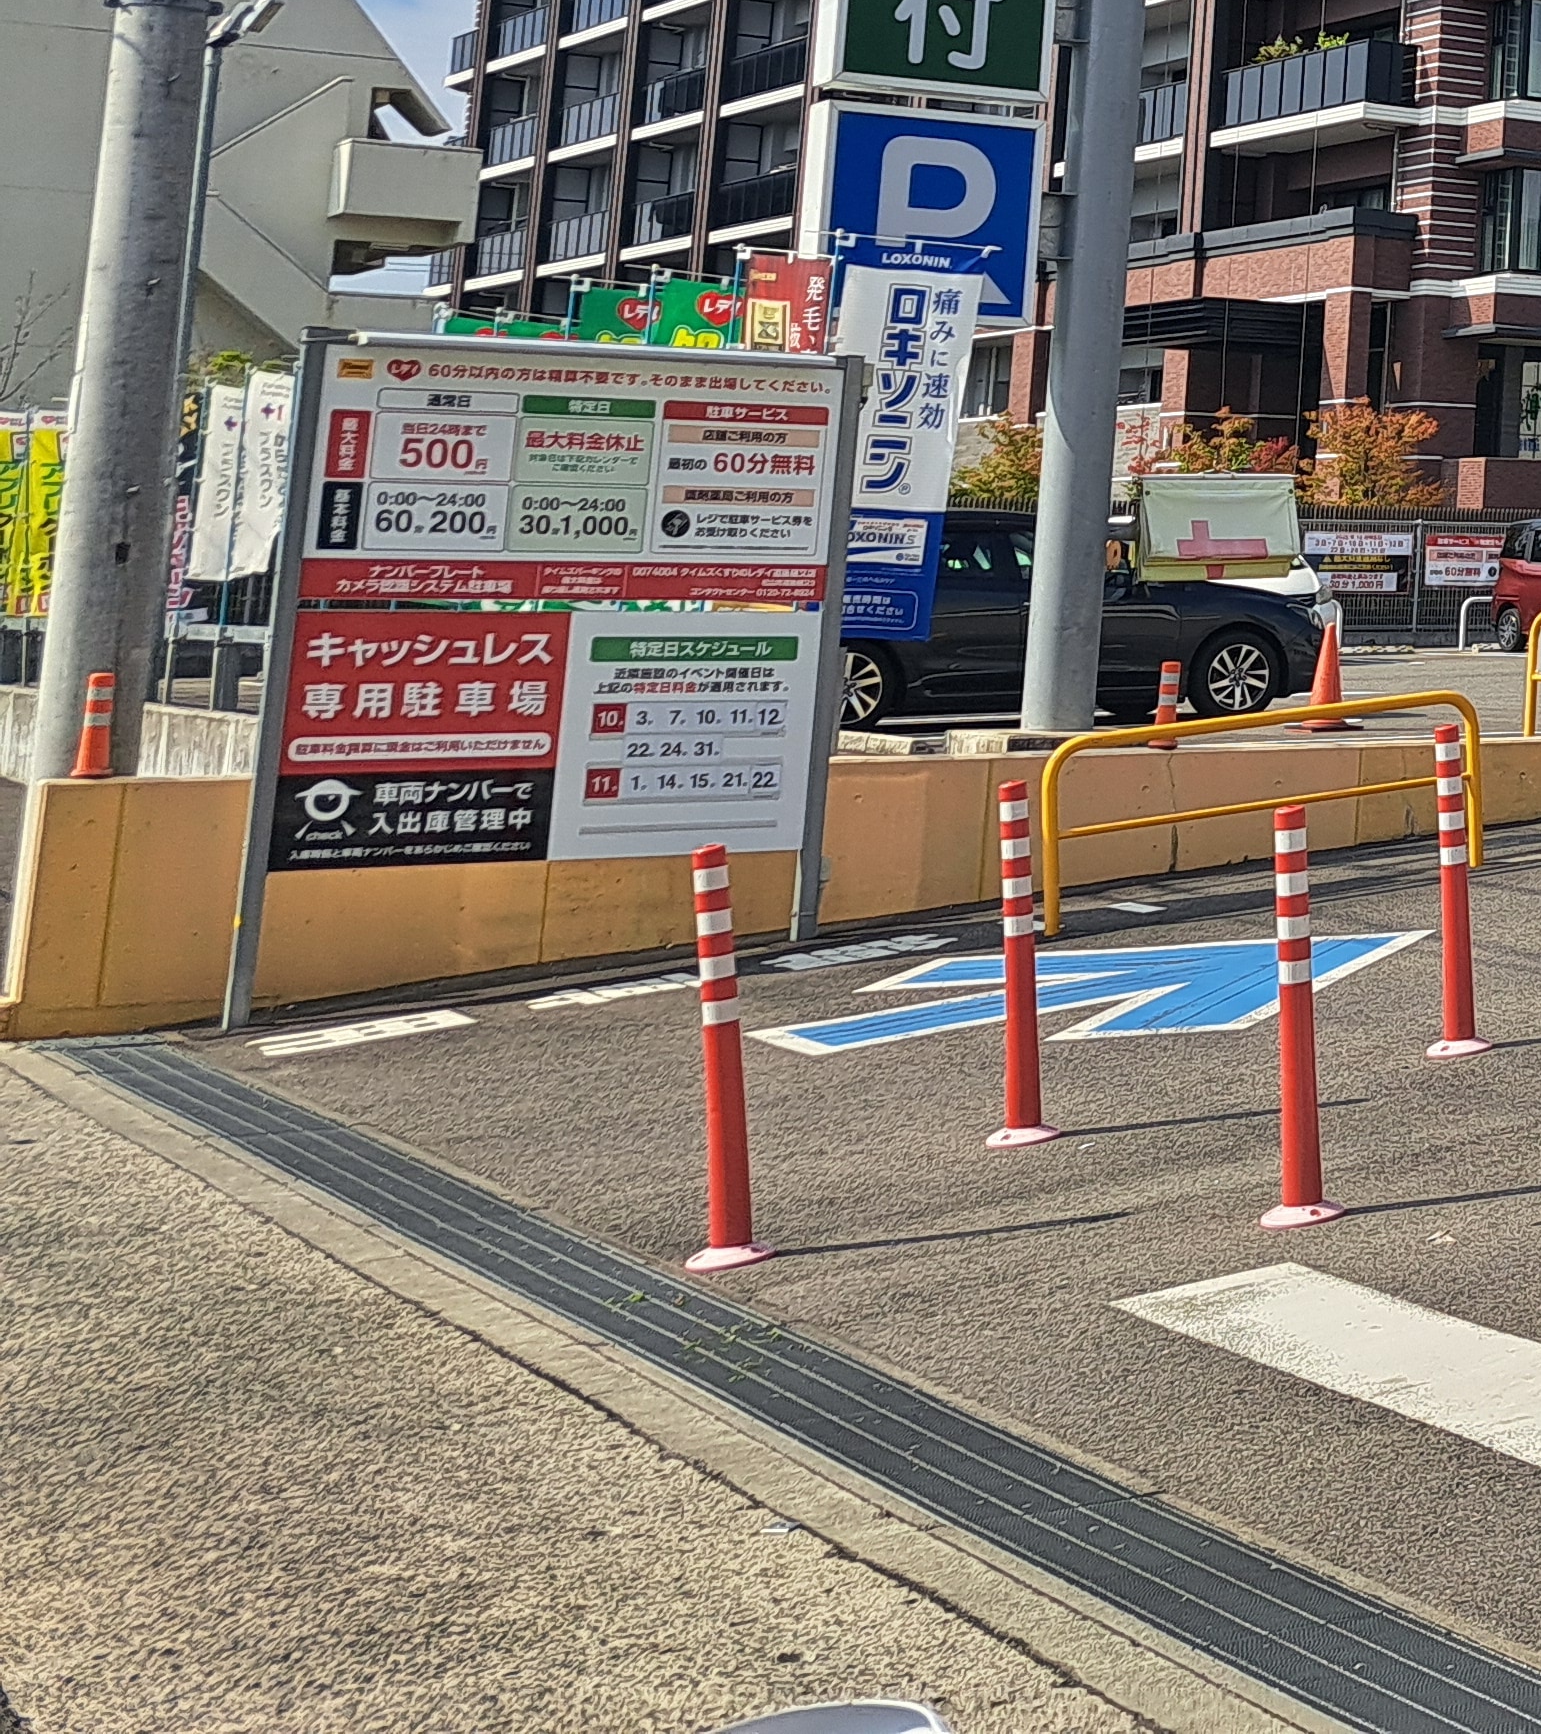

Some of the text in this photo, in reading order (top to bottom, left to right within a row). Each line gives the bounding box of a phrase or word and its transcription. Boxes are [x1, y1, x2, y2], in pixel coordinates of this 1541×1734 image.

[874, 134, 997, 249] P
[881, 252, 952, 269] LOXONIN
[801, 276, 825, 354] 発毛、
[916, 288, 963, 430] 痛みに速効
[859, 284, 932, 494] ロキソニン
[705, 405, 788, 421] 駐車サービス
[525, 430, 645, 452] 最大料金休止
[702, 429, 788, 444] 店舗ご利用の方
[400, 438, 488, 471] 500円
[667, 453, 816, 476] 最初の 60分無料
[694, 526, 791, 539] お受け取りください
[369, 565, 485, 578] ナンバープレート
[306, 632, 554, 668] キャッシュレス
[629, 640, 773, 658] 特定日スケジュール
[301, 680, 549, 720] 専用駐車場
[372, 778, 534, 807] 車両ナンバーで
[367, 808, 534, 836] 入出庫管理中
